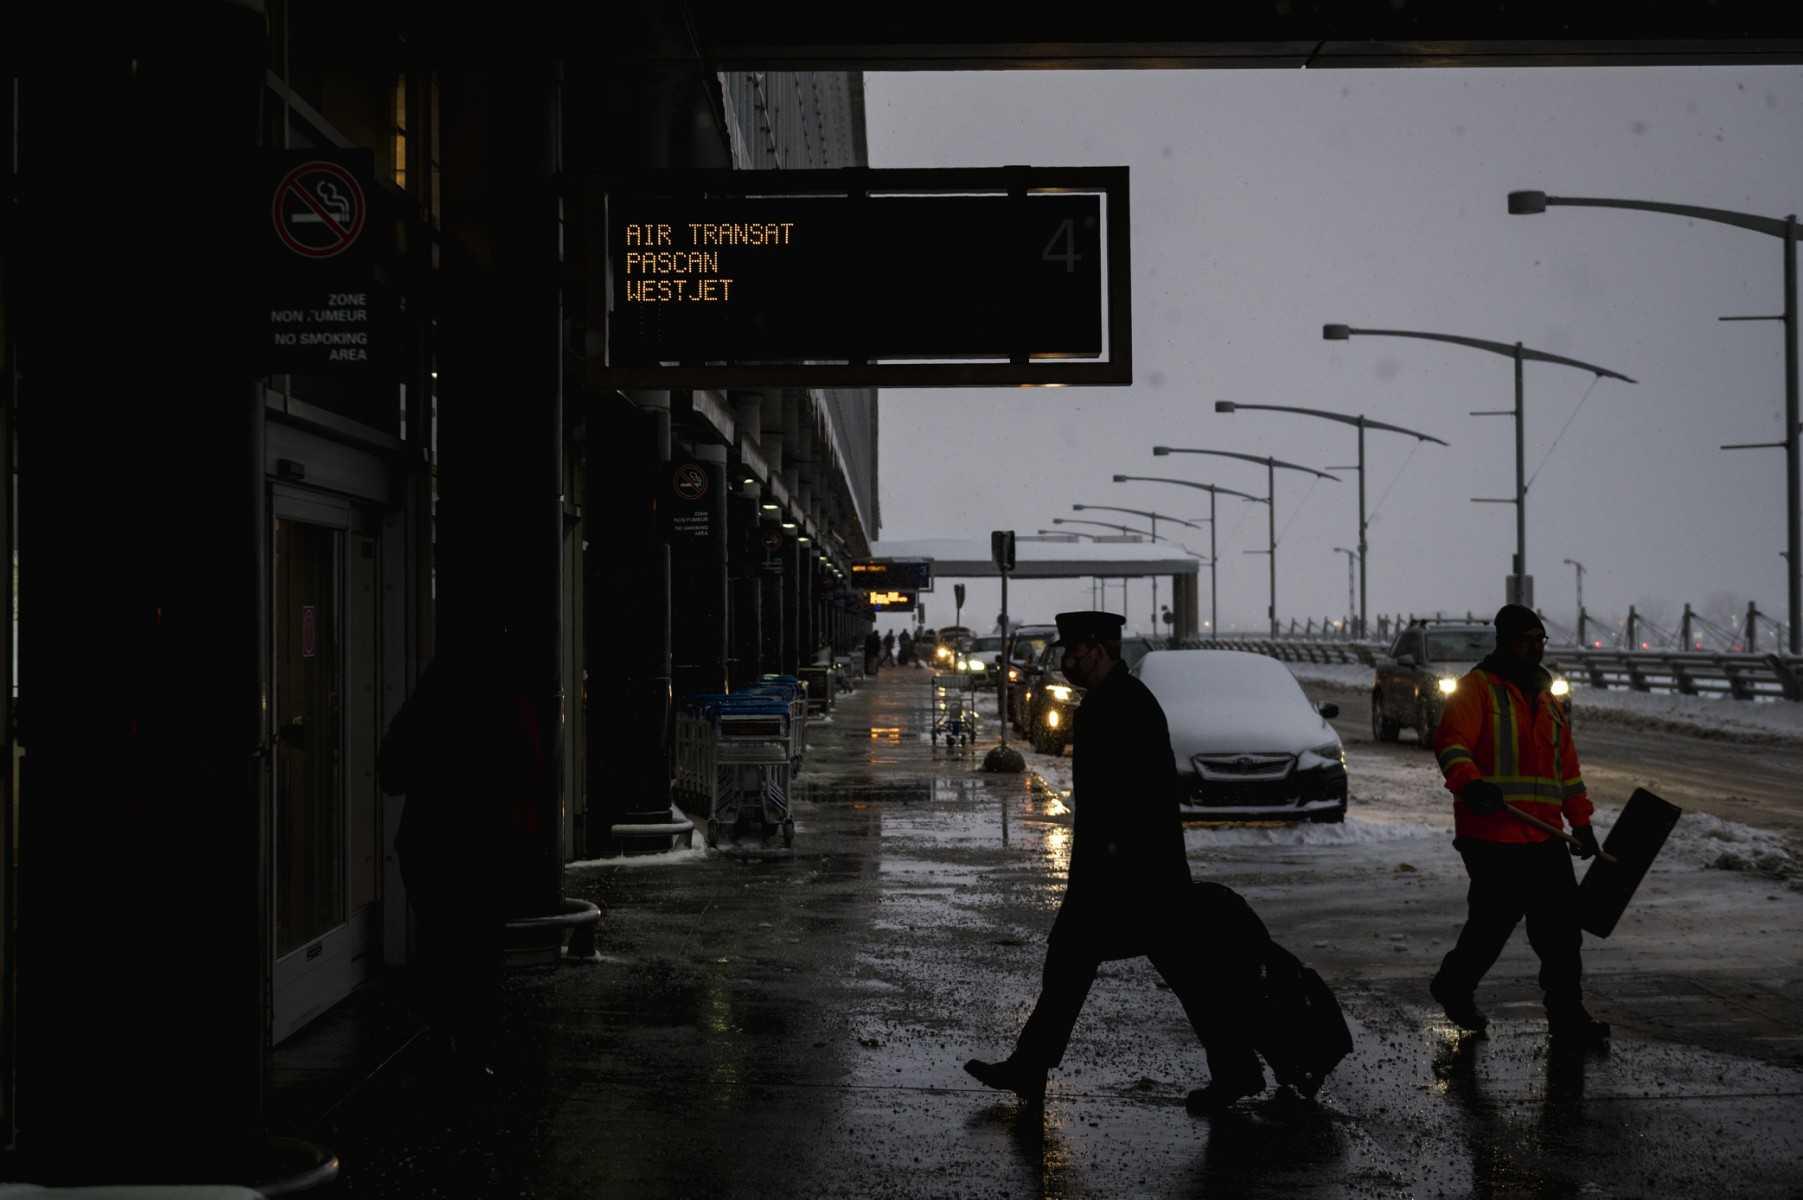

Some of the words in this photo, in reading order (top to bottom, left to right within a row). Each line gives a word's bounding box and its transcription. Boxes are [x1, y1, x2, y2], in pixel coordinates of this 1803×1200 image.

[625, 223, 672, 247] AIR
[688, 222, 794, 247] TRANSAT
[1041, 218, 1082, 273] 4
[625, 251, 718, 273] PASCAN
[626, 279, 734, 302] WESTJET
[328, 294, 367, 306] ZONE
[271, 310, 303, 322] NON
[274, 333, 296, 345] NO
[299, 332, 367, 345] SMOKING
[329, 349, 367, 361] AREA
